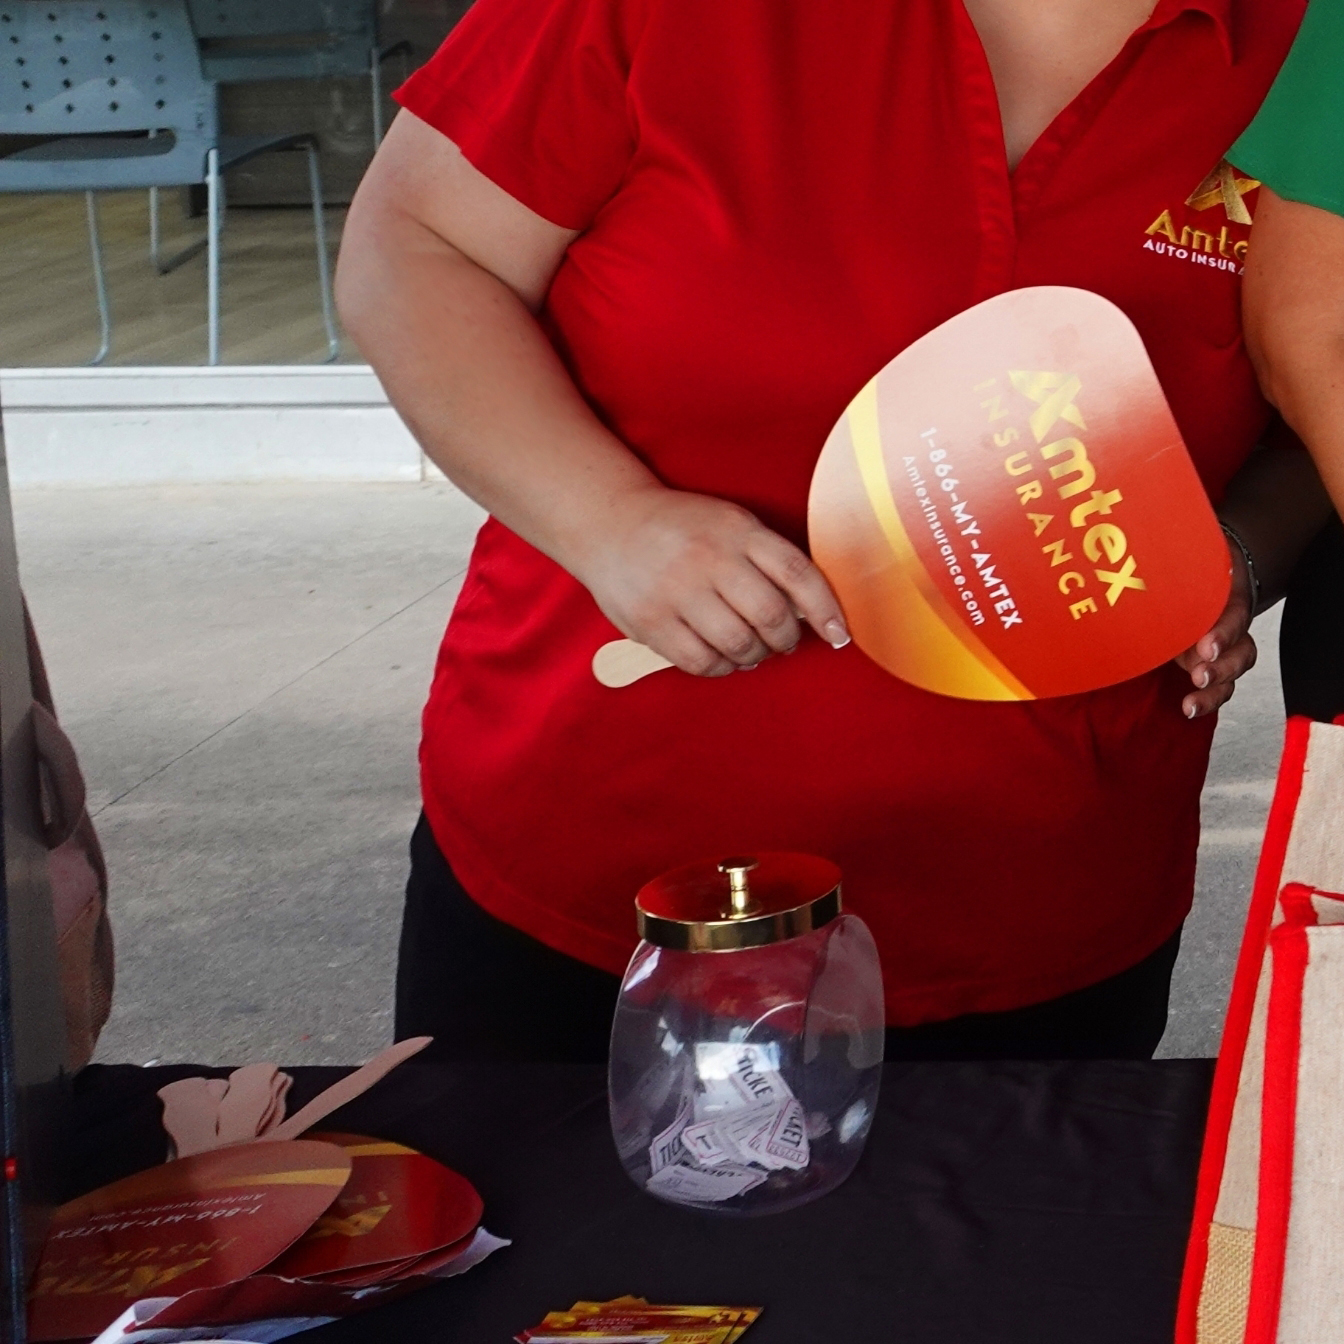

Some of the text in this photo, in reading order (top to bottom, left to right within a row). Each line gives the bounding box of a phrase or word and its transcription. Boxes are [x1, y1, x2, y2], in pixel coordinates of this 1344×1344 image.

[1142, 238, 1188, 259] AUTO
[901, 455, 986, 628] AmtexInsurance.com
[919, 426, 1024, 631] 1-866-MY-AMTEX
[972, 377, 1099, 621] INSURANCE
[1008, 369, 1148, 607] Amtex
